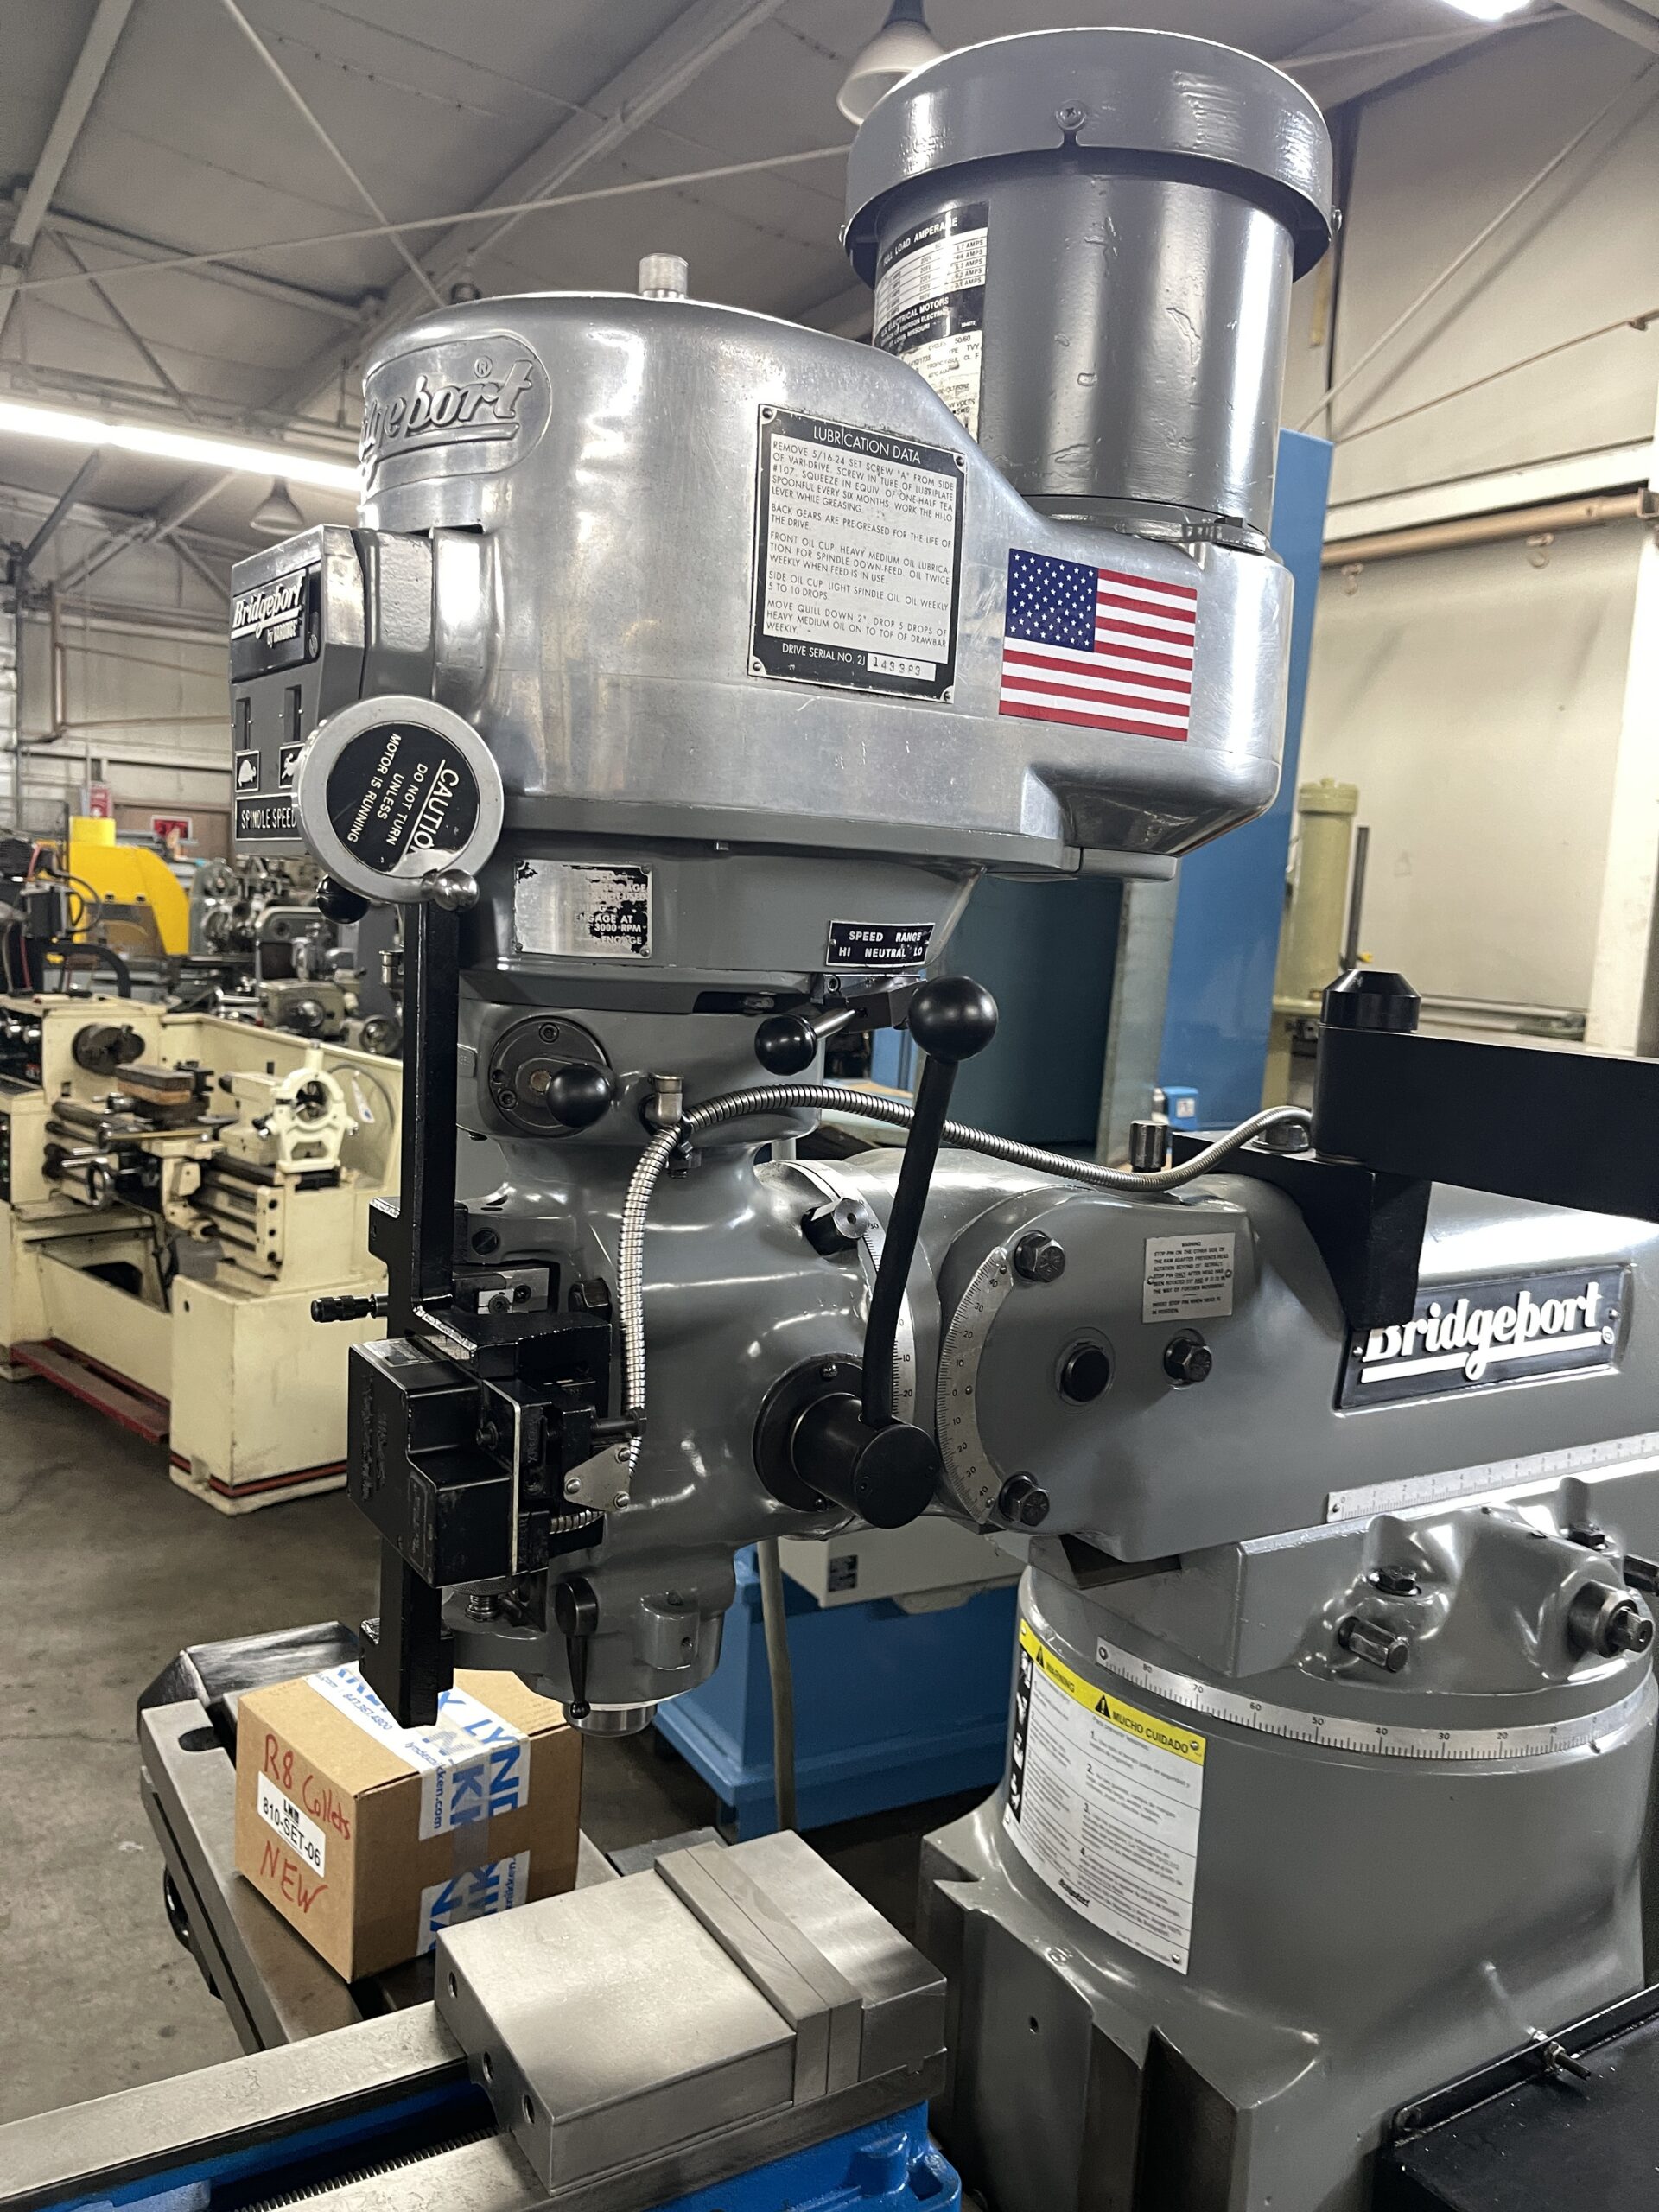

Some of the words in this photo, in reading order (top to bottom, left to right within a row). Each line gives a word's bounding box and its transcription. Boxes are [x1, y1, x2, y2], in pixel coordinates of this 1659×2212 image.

[894, 238, 911, 255] LOAD
[913, 218, 958, 242] AMPERAE
[967, 239, 983, 248] AMPS
[965, 258, 982, 267] AMPS
[966, 249, 983, 257] AMPS
[964, 277, 982, 286] AMPS
[965, 268, 982, 276] AMPS
[919, 296, 949, 313] MOTORS
[813, 425, 890, 455] LUBRICATION
[893, 445, 920, 464] DATA
[772, 440, 808, 456] REMOVE
[811, 448, 845, 466] 5/16-24
[849, 458, 861, 469] SET
[912, 473, 934, 486] FROM
[938, 479, 954, 491] SIDE
[772, 451, 785, 462] OF
[836, 466, 864, 481] SCREW
[868, 474, 877, 484] IN
[880, 476, 898, 488] TUBE
[901, 481, 912, 492] OF
[771, 486, 794, 499] LEVER
[796, 491, 820, 505] WHILE
[772, 474, 815, 492] SPOONFUL
[817, 484, 840, 498] EVERY
[842, 490, 853, 500] SIX
[893, 501, 917, 514] WORK
[918, 507, 931, 518] THE
[801, 469, 838, 486] SQUEEZE
[842, 479, 851, 489] IN
[884, 488, 895, 499] OF
[939, 501, 952, 512] TEA
[771, 513, 785, 525] THE
[771, 502, 792, 515] BACK
[796, 507, 822, 521] GEARS
[824, 513, 839, 525] ARE
[842, 518, 890, 536] PRE-GREASED
[893, 528, 907, 539] FOR
[910, 531, 923, 543] THE
[925, 535, 938, 546] LIFE
[941, 538, 950, 549] OF
[770, 531, 798, 544] FRONT
[801, 537, 815, 548] OIL
[839, 544, 866, 558] HEAVY
[868, 550, 899, 565] MEDIUM
[902, 557, 915, 568] OIL
[769, 542, 791, 555] TION
[796, 547, 812, 559] FOR
[816, 551, 849, 566] SPINDLE
[908, 569, 921, 580] OIL
[925, 573, 949, 585] TWICE
[769, 553, 800, 568] WEEKLY
[802, 560, 828, 573] WHEN
[830, 565, 849, 576] FEED
[850, 569, 858, 578] IS
[860, 570, 868, 581] IN
[767, 582, 773, 591] 5
[776, 582, 787, 594] TO
[790, 585, 800, 595] 10
[768, 570, 786, 582] SIDE
[790, 574, 803, 585] OIL
[828, 581, 850, 594] LIGHT
[853, 586, 884, 600] SPINDLE
[904, 595, 917, 606] OIL
[919, 598, 948, 611] WEEKLY
[232, 575, 302, 639] Bridgeport
[767, 598, 793, 611] MOVE
[797, 603, 820, 615] QUILL
[824, 608, 854, 621] DOWN
[873, 617, 895, 628] DROP
[899, 621, 903, 630] 5
[906, 622, 933, 635] DROPS
[936, 627, 947, 637] OF
[766, 609, 792, 622] HEAVY
[796, 614, 830, 628] MEDIUM
[832, 620, 845, 631] OIL
[848, 623, 862, 634] ON
[865, 626, 875, 636] TO
[879, 628, 894, 639] TOP
[897, 632, 907, 641] OF
[910, 633, 946, 648] DRAWBAR
[782, 642, 806, 657] DRIVE
[809, 645, 836, 660] SERIAL
[837, 649, 855, 663] NO.
[377, 733, 402, 775] MOTOR
[371, 776, 384, 789] IS
[413, 762, 428, 782] DO
[377, 772, 404, 820] UNLESS
[402, 784, 419, 810] NOT
[241, 809, 270, 829] SPINDLE
[347, 790, 378, 843] RUNNING
[386, 812, 408, 845] TURN
[594, 923, 617, 932] 3000
[620, 923, 641, 932] RPM
[620, 915, 633, 924] AT
[849, 931, 884, 942] SPEED
[895, 931, 923, 943] RANGE
[838, 946, 851, 957] HI
[864, 948, 906, 958] NEUTRAL
[913, 946, 923, 957] LO
[974, 1302, 984, 1313] 30
[963, 1330, 973, 1339] 20
[903, 1354, 911, 1363] 10
[952, 1417, 962, 1426] 10
[957, 1441, 968, 1452] 20
[966, 1465, 976, 1478] 30
[979, 1485, 988, 1497] 40
[1192, 1684, 1204, 1694] 70
[1249, 1701, 1262, 1712] 60
[1312, 1716, 1325, 1726] 50
[1375, 1727, 1389, 1736] 40
[1437, 1732, 1451, 1741] 30
[1497, 1731, 1508, 1740] 20
[1112, 1711, 1144, 1734] MUCHO
[1145, 1728, 1190, 1754] CUIDADO
[264, 1733, 295, 1790] R8
[263, 1796, 321, 1867] 810-SET-06
[260, 1840, 328, 1914] NEW
